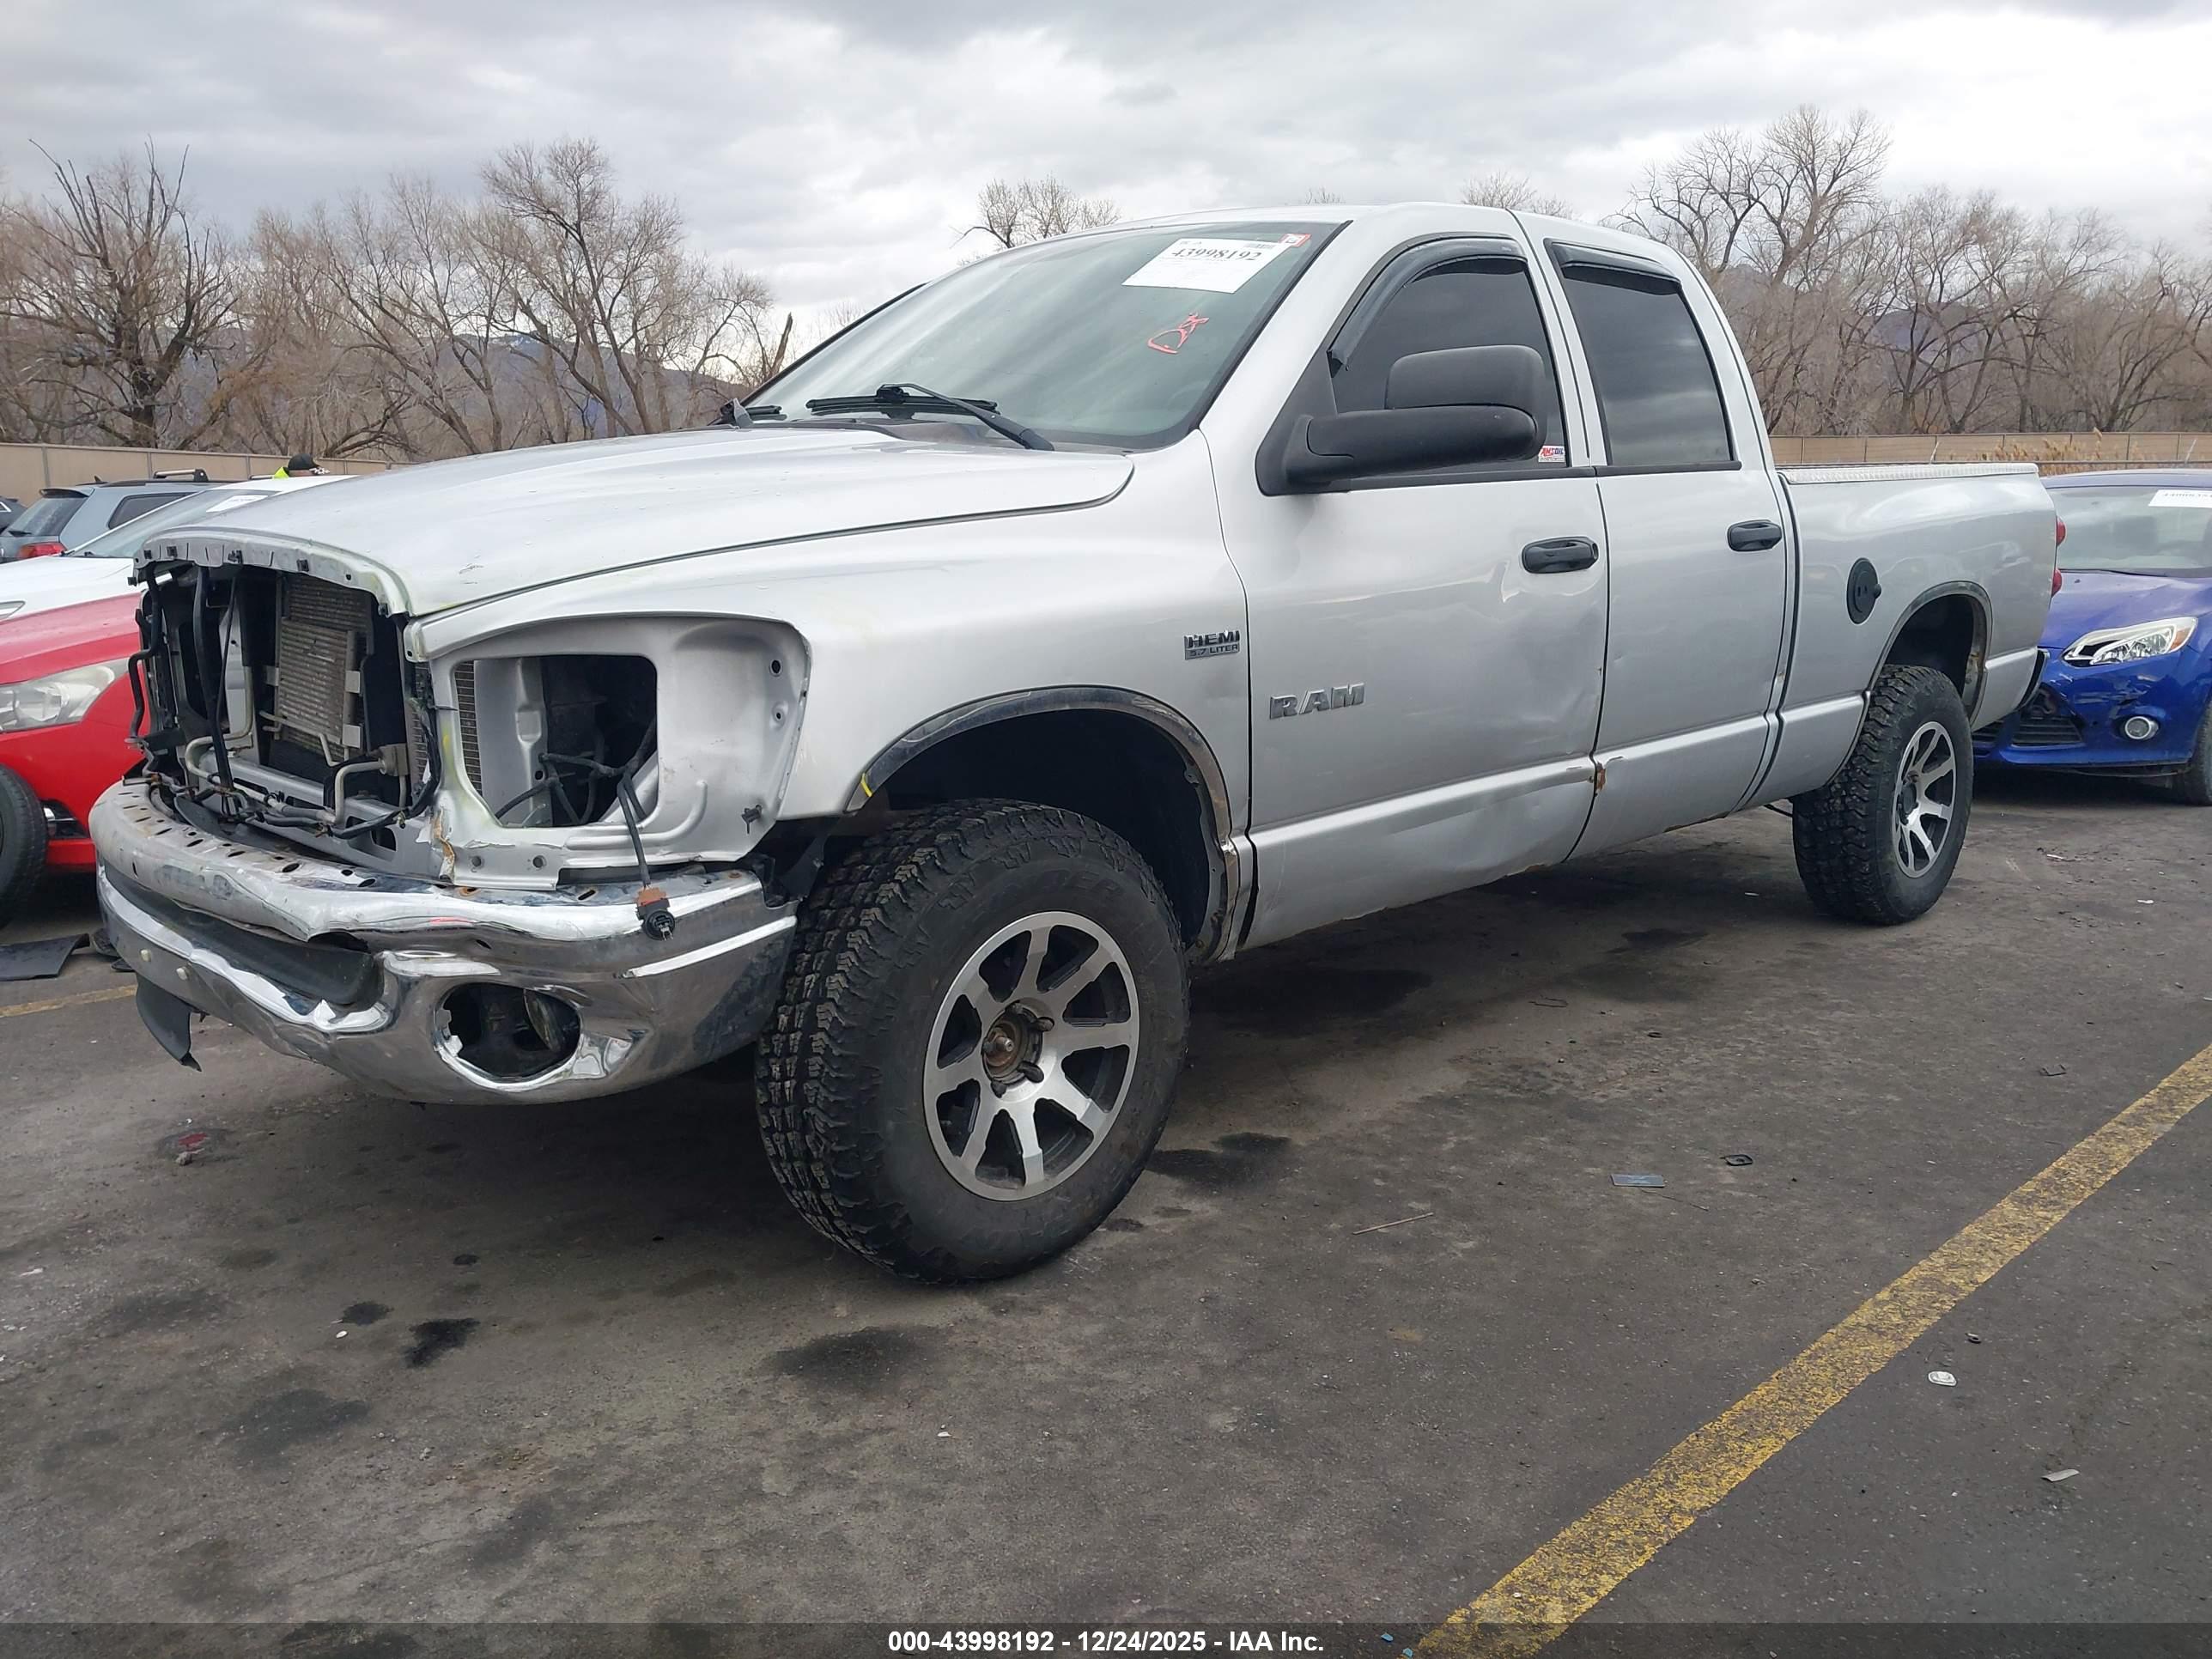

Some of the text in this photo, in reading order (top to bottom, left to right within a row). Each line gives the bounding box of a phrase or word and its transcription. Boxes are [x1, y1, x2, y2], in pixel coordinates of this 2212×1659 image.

[1170, 247, 1262, 261] 43998192
[1183, 629, 1241, 648] HEMI
[1189, 644, 1238, 658] 5.7 LITER
[1269, 683, 1365, 720] RAM
